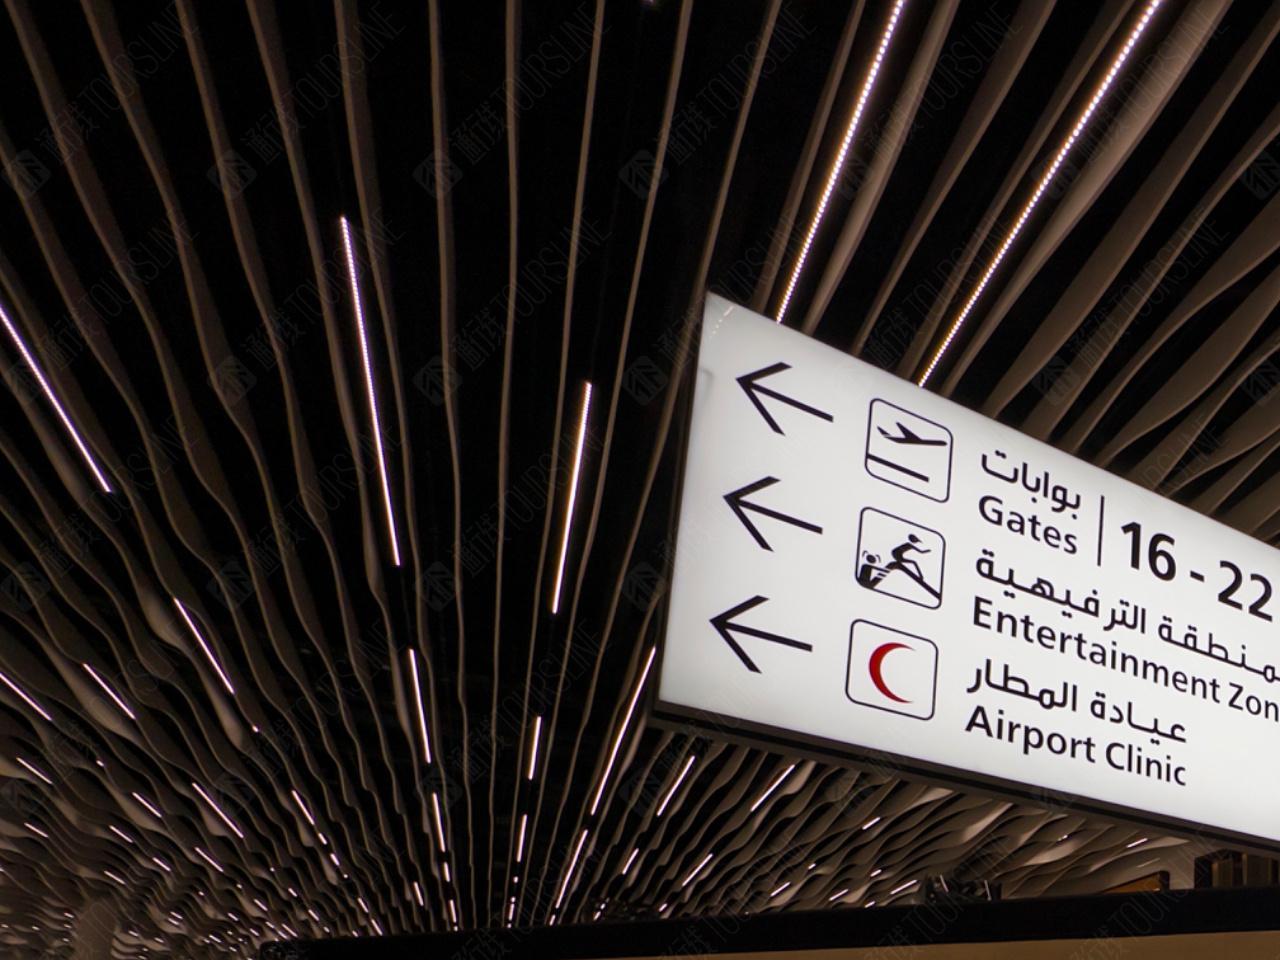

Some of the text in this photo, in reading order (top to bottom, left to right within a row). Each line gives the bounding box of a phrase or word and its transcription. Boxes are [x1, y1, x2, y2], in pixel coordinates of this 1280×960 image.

[978, 495, 1078, 555] Gates
[981, 449, 1081, 520] بوابات
[975, 548, 1147, 635] الترفيهية
[1120, 521, 1177, 582] 16
[1217, 560, 1273, 623] 22
[973, 595, 1221, 704] Entertainment
[966, 658, 1187, 746] عيادة المطار
[964, 705, 1186, 787] Airport Clinic
